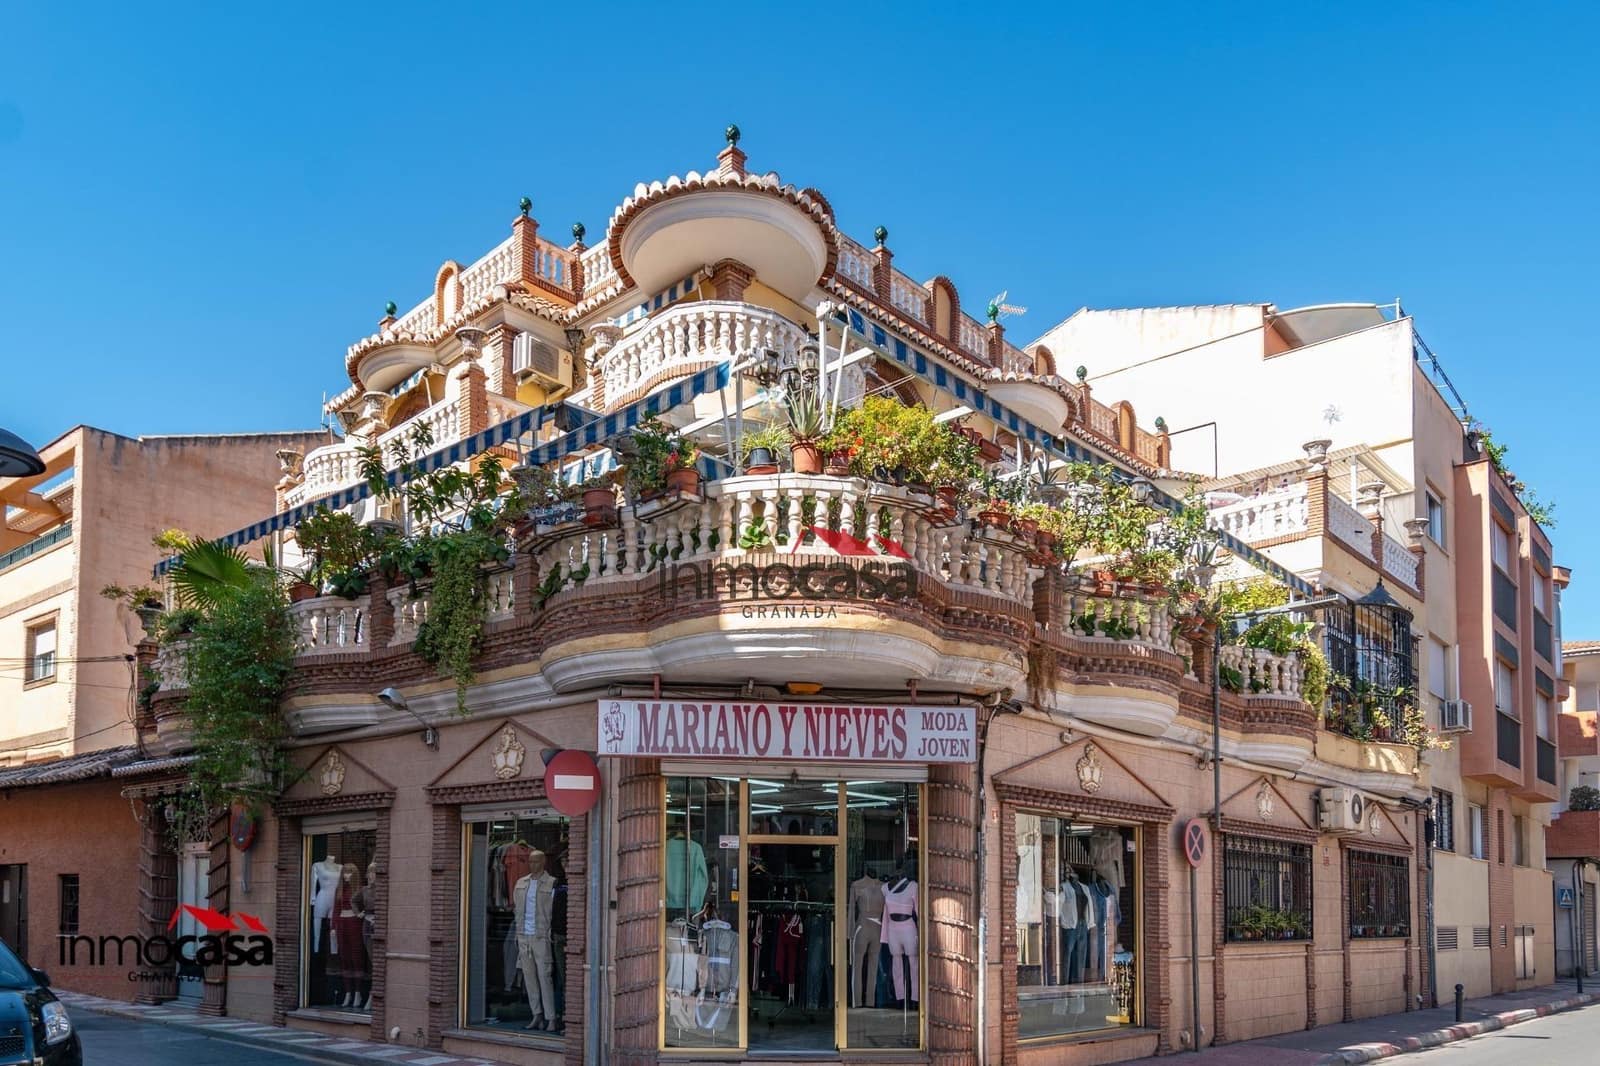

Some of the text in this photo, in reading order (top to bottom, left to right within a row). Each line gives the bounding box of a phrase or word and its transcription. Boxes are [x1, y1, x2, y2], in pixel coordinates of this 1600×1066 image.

[636, 703, 907, 759] MARIANO Y NIEVES
[921, 711, 968, 732] MODA
[918, 737, 969, 758] JOVEN
